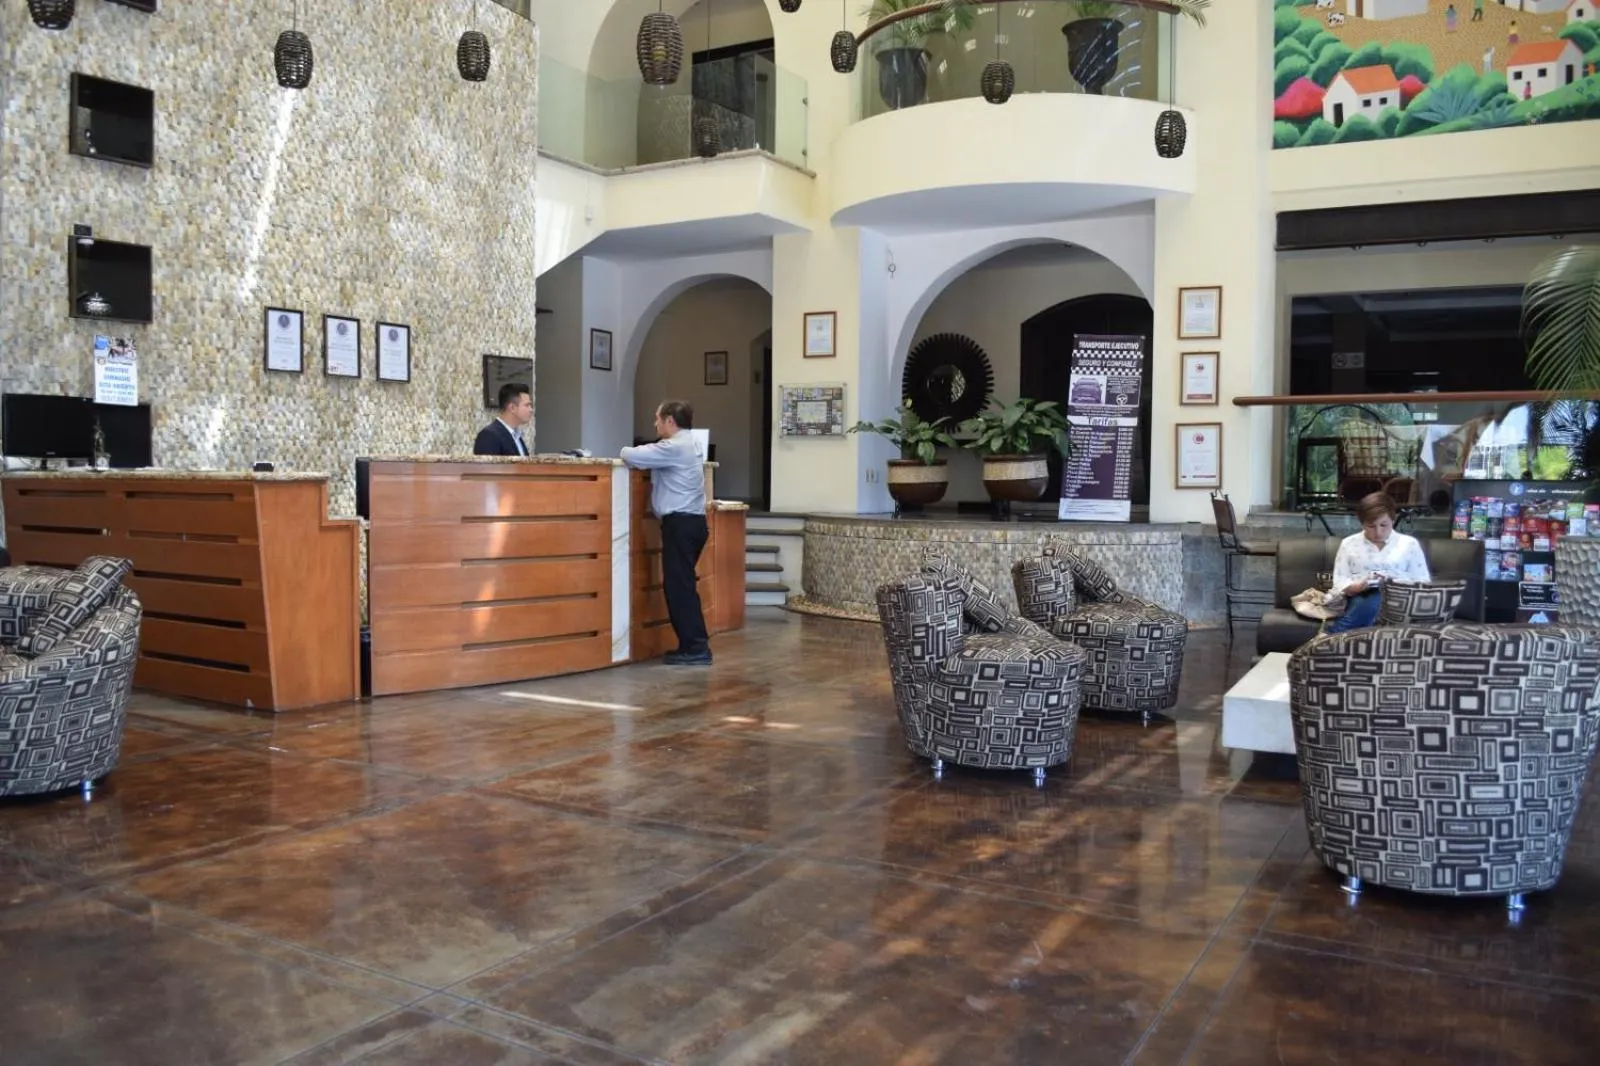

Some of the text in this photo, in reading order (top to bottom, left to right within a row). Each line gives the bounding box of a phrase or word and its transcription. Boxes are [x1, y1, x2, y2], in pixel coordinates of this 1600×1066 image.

[1079, 341, 1139, 350] TRANSPORTE EJECUTIVO
[1107, 360, 1137, 368] CONFIABLE
[1088, 416, 1118, 426] Tarifas
